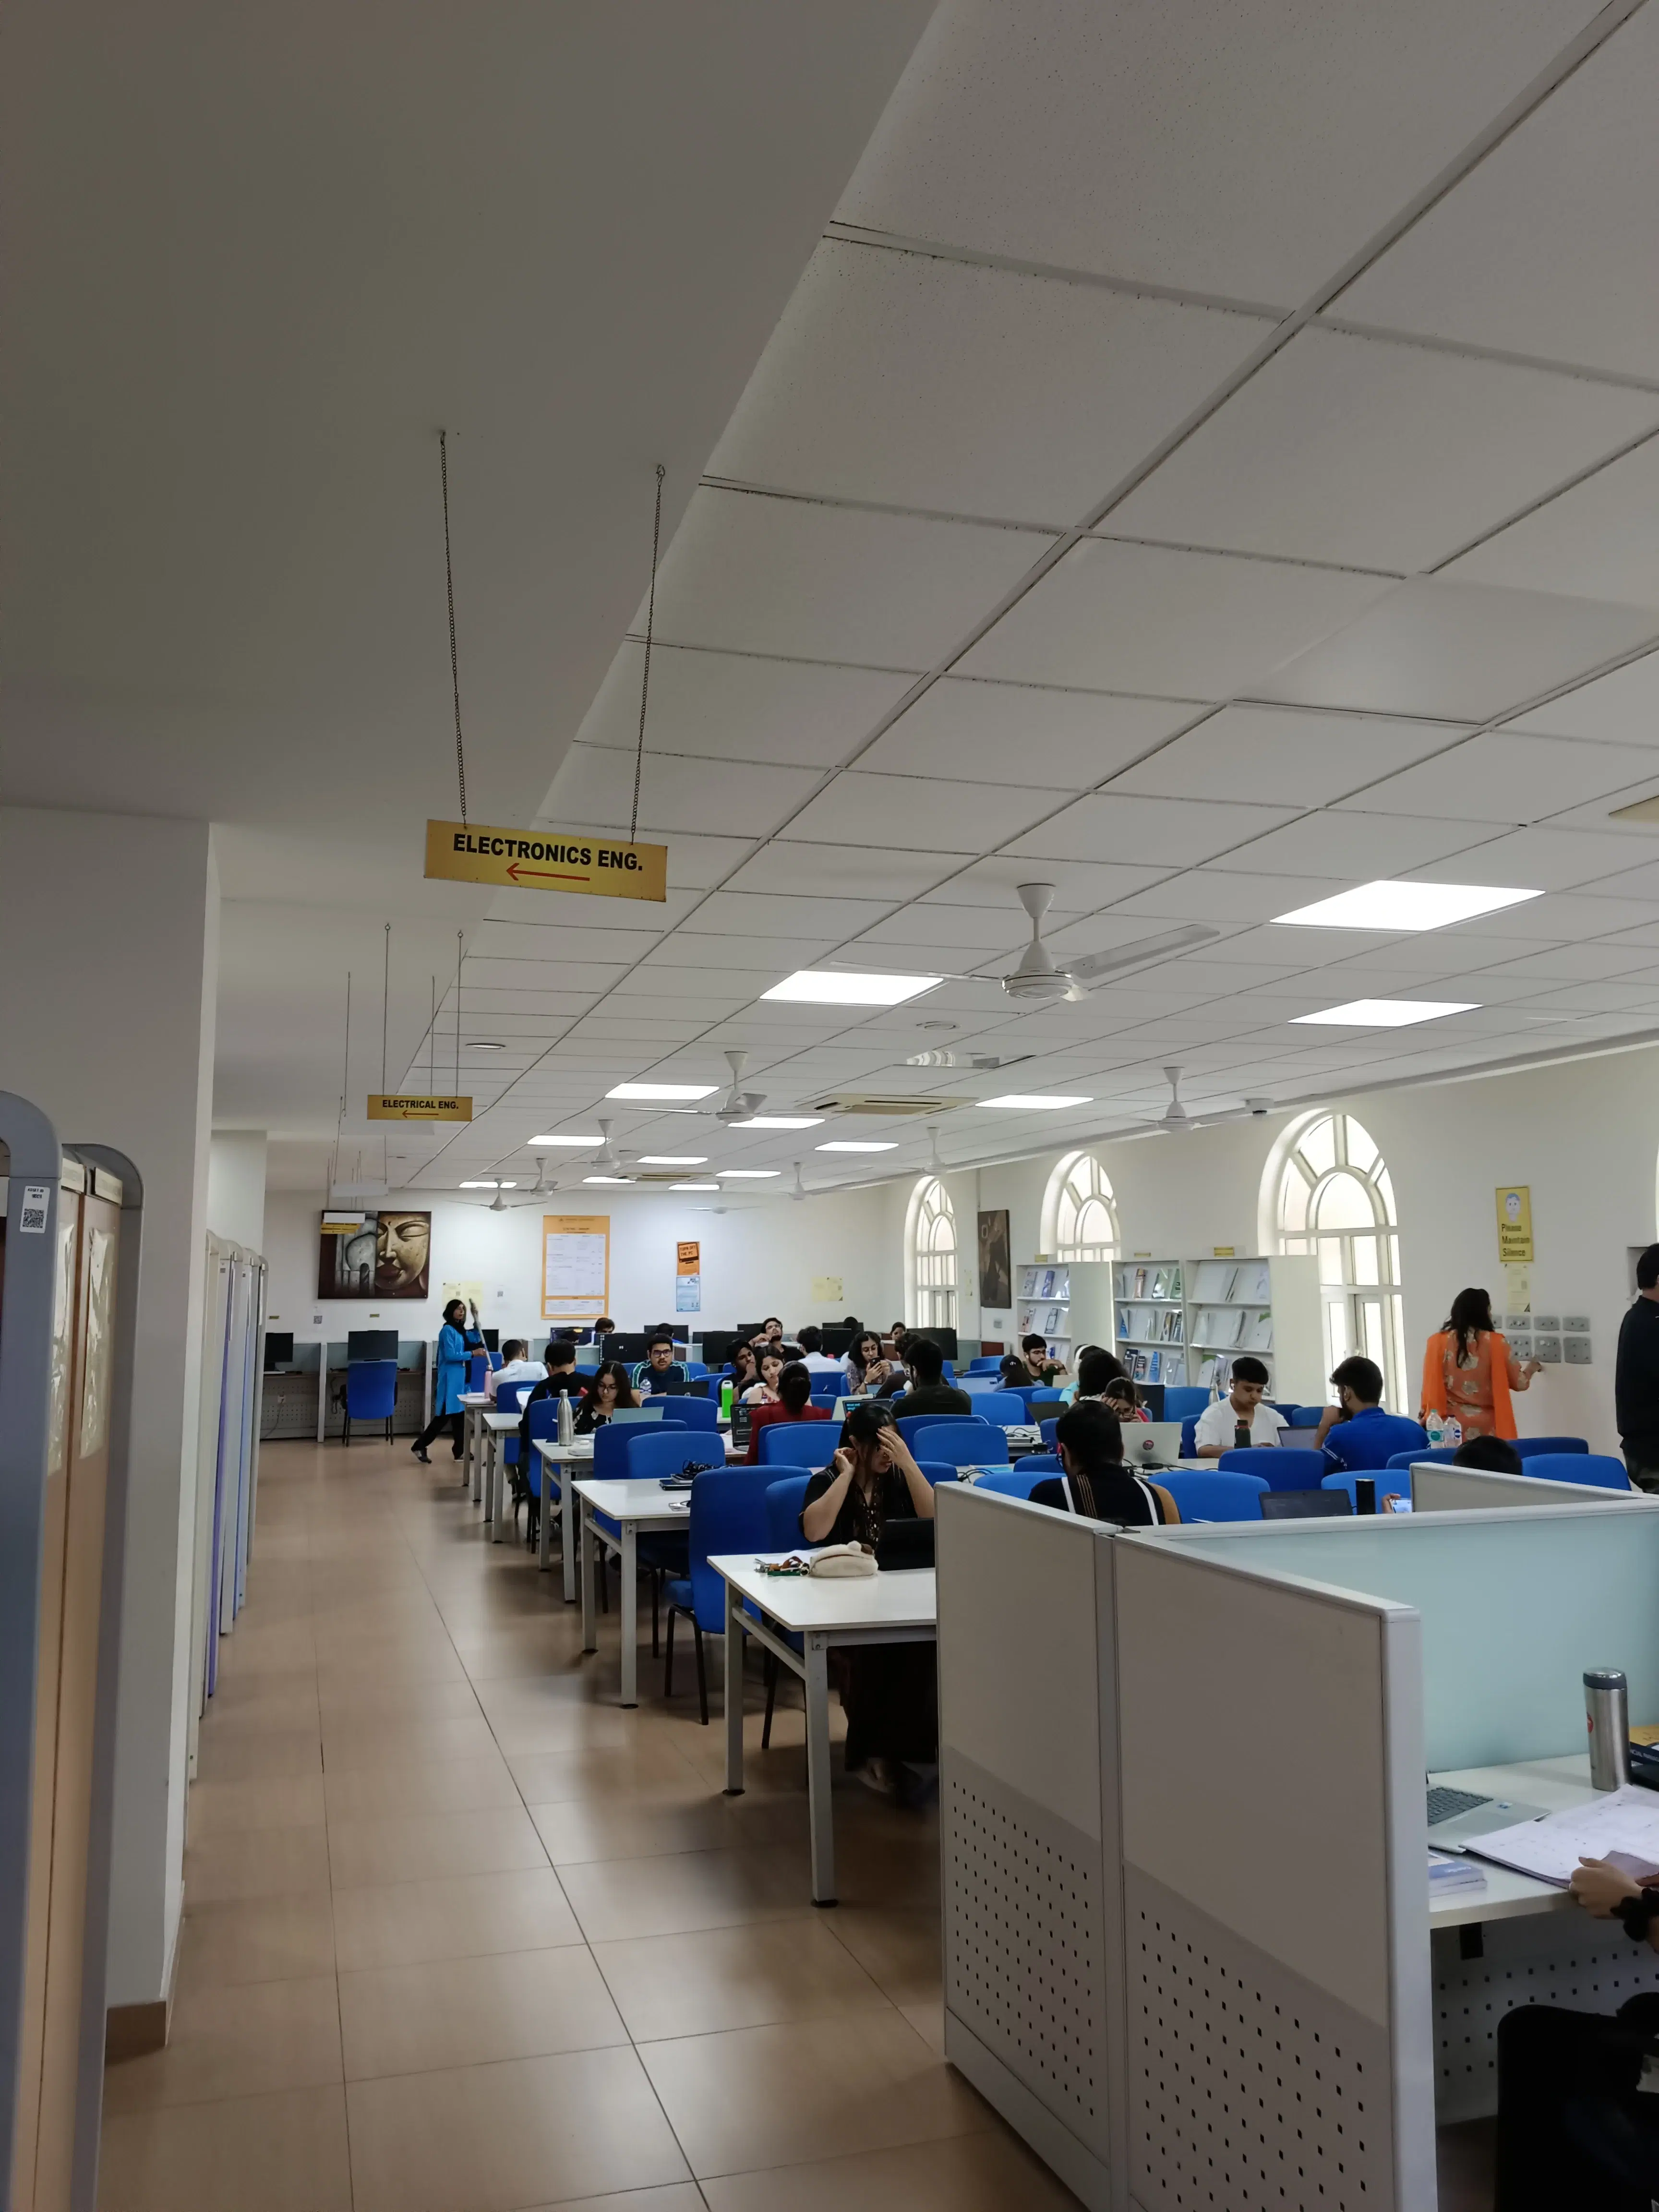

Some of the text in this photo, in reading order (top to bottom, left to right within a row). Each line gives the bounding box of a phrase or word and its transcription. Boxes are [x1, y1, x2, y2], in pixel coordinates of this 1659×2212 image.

[454, 833, 642, 871] ELECTRONICS ENG.
[382, 1100, 459, 1109] ELECTRICAL ENG.
